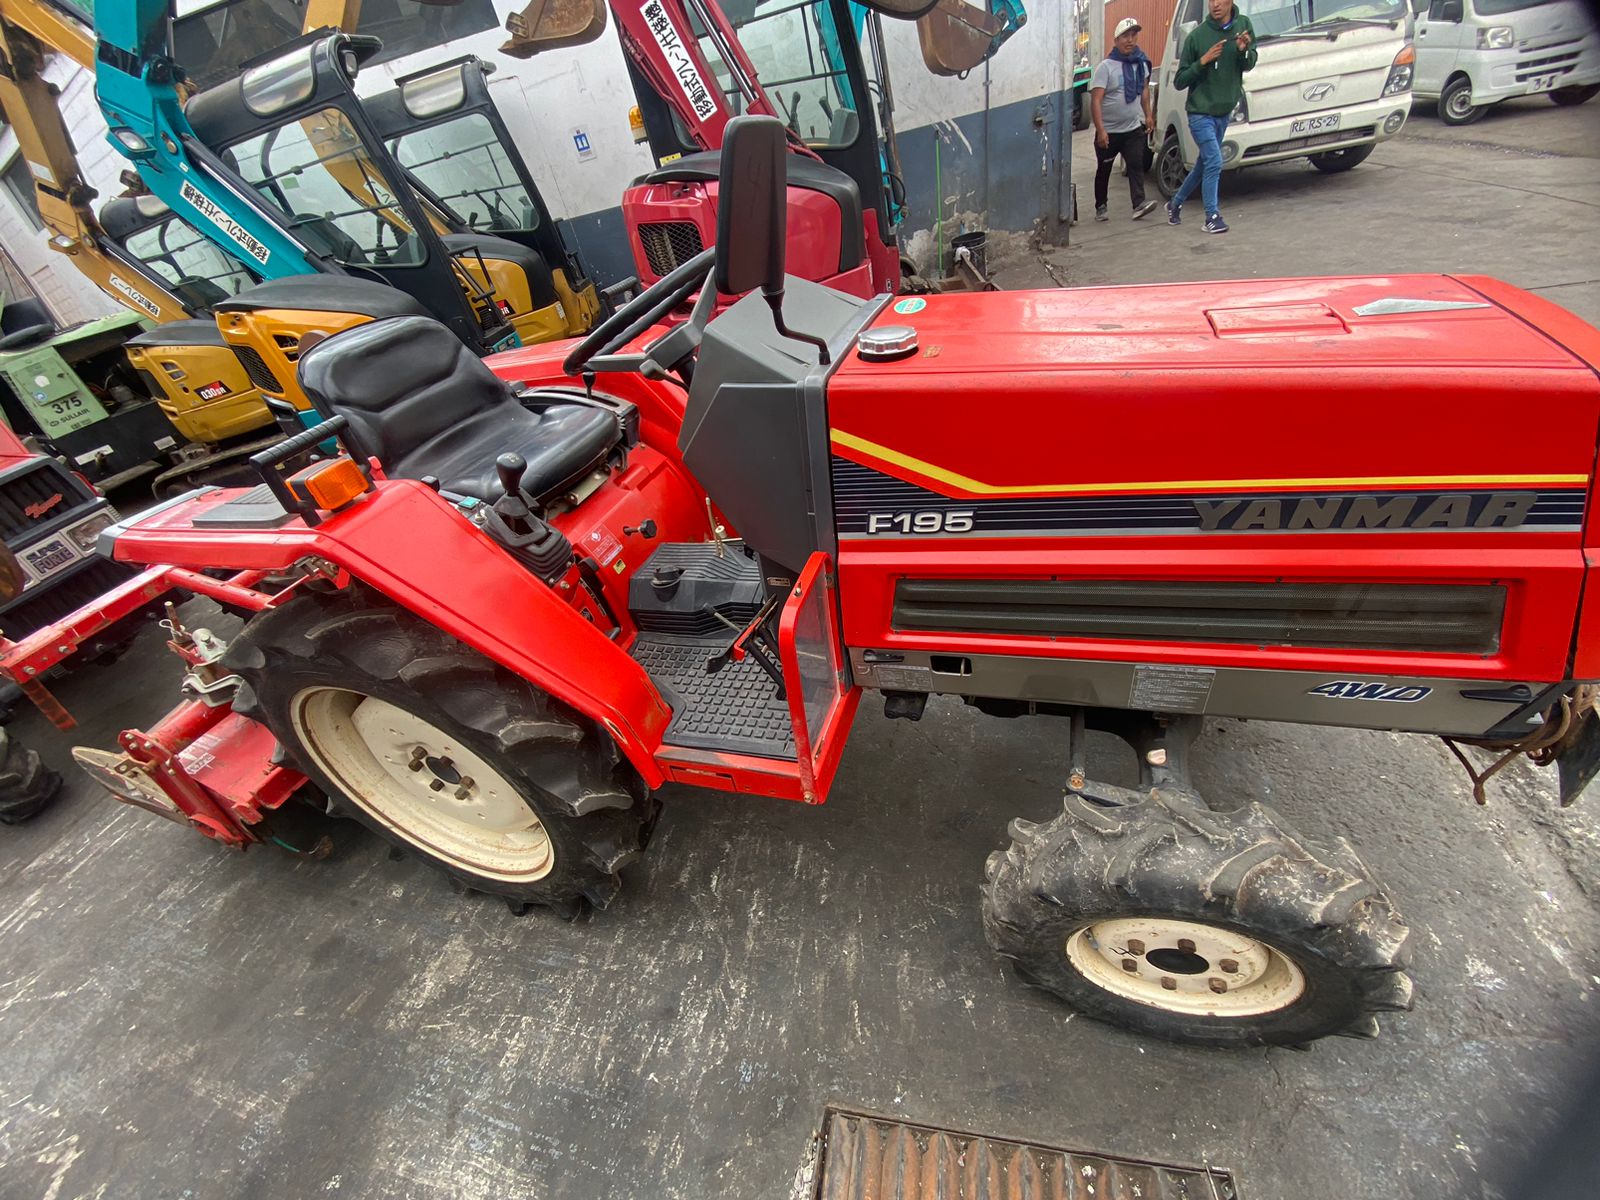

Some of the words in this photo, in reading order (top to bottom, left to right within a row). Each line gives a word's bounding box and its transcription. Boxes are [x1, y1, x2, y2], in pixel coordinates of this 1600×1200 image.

[51, 396, 82, 415] 375
[867, 510, 976, 533] F195
[1193, 492, 1538, 530] YANMAR
[26, 540, 65, 563] SUPER
[33, 547, 76, 575] FORTE
[1306, 680, 1435, 702] 4WD
